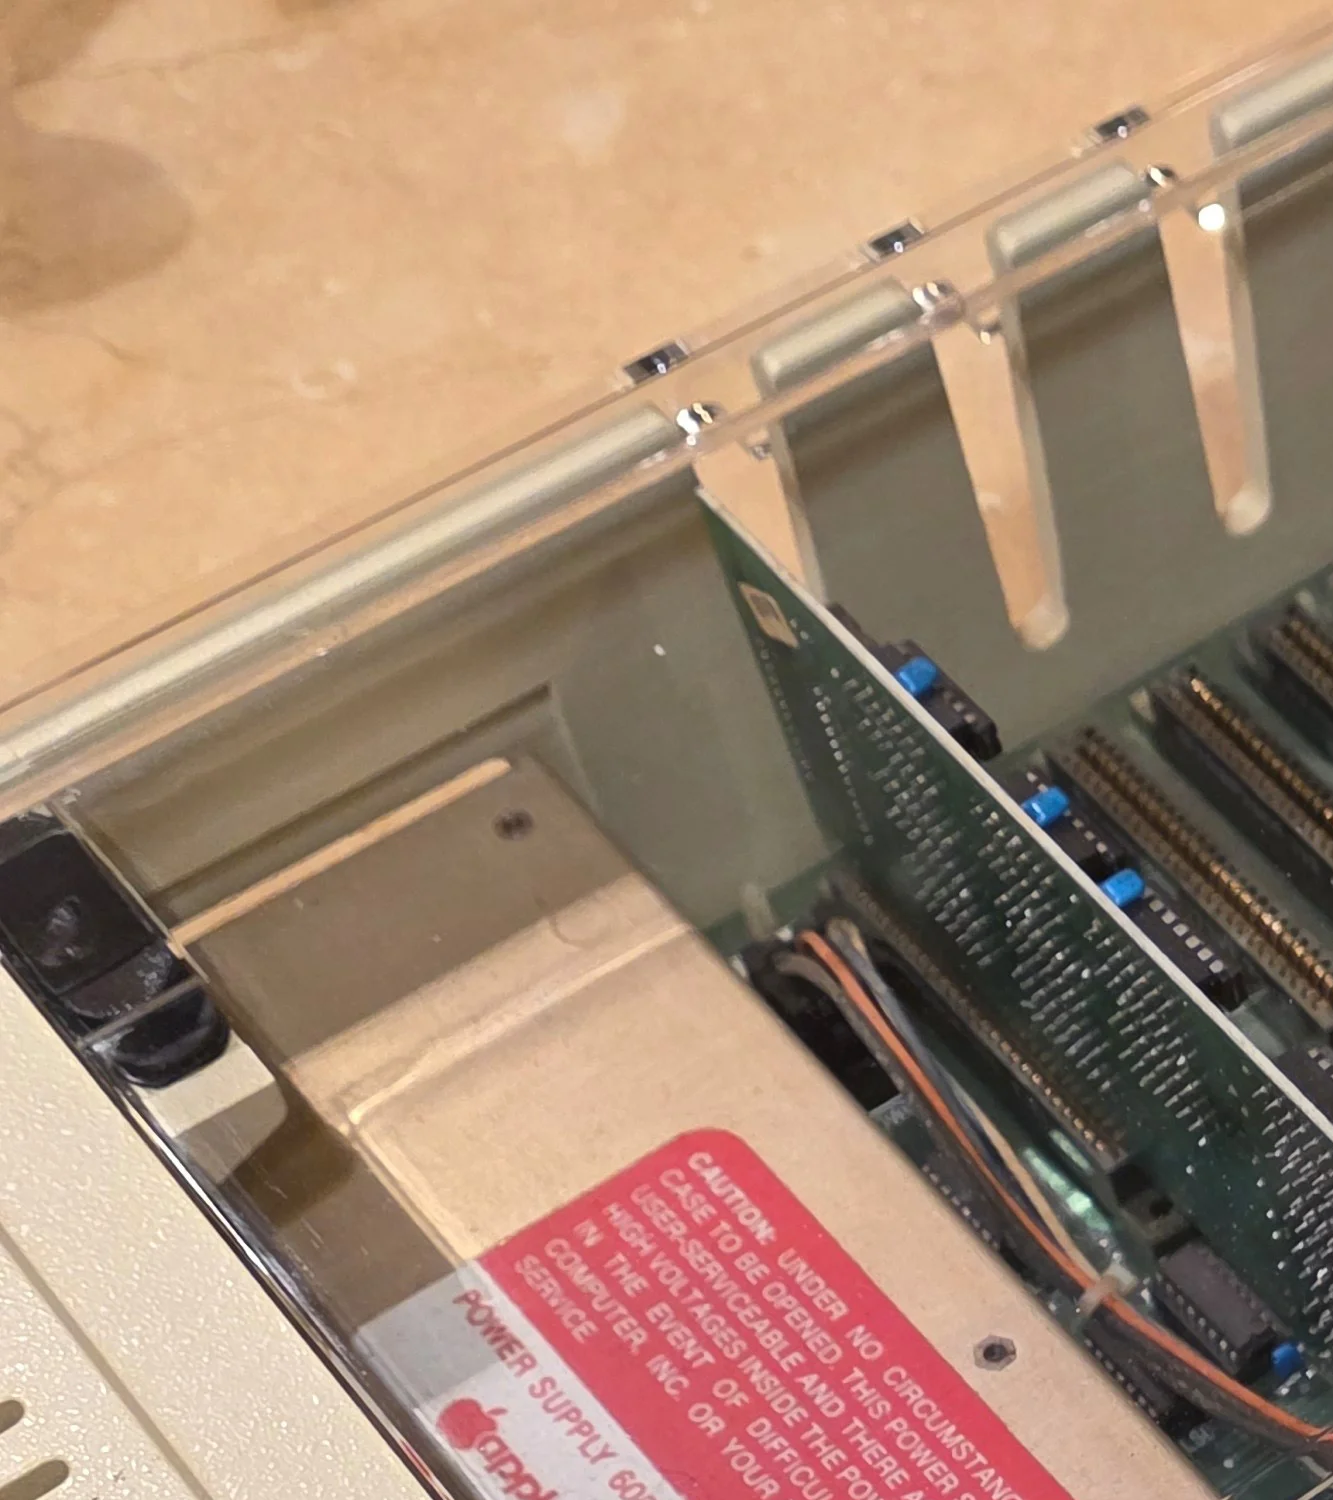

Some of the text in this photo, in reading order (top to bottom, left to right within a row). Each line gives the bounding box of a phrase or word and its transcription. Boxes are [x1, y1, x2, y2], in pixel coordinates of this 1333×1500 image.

[514, 1256, 597, 1342] SERVICE
[571, 1220, 602, 1247] IN
[601, 1254, 646, 1296] THE
[644, 1303, 712, 1371] EVENT
[709, 1377, 747, 1411] OF
[600, 1203, 654, 1255] HIGH
[645, 1254, 746, 1358] VOLTAGES
[737, 1357, 806, 1425] INSIDE
[797, 1425, 844, 1468] THE
[628, 1186, 803, 1370] USER-SERVICEABLE
[795, 1372, 844, 1417] AND
[838, 1419, 907, 1488] THERE
[657, 1168, 714, 1223] CASE
[707, 1222, 741, 1253] TO
[734, 1252, 768, 1282] BE
[760, 1282, 845, 1368] OPENED.
[839, 1369, 890, 1417] THIS
[883, 1418, 958, 1492] POWER
[686, 1150, 779, 1244] CAUTION:
[775, 1249, 848, 1320] UNDER
[844, 1325, 884, 1360] NO
[453, 1290, 536, 1376] POWER
[527, 1375, 616, 1467] SUPPLY
[685, 1401, 724, 1437] OR
[717, 1439, 778, 1499] YOUR
